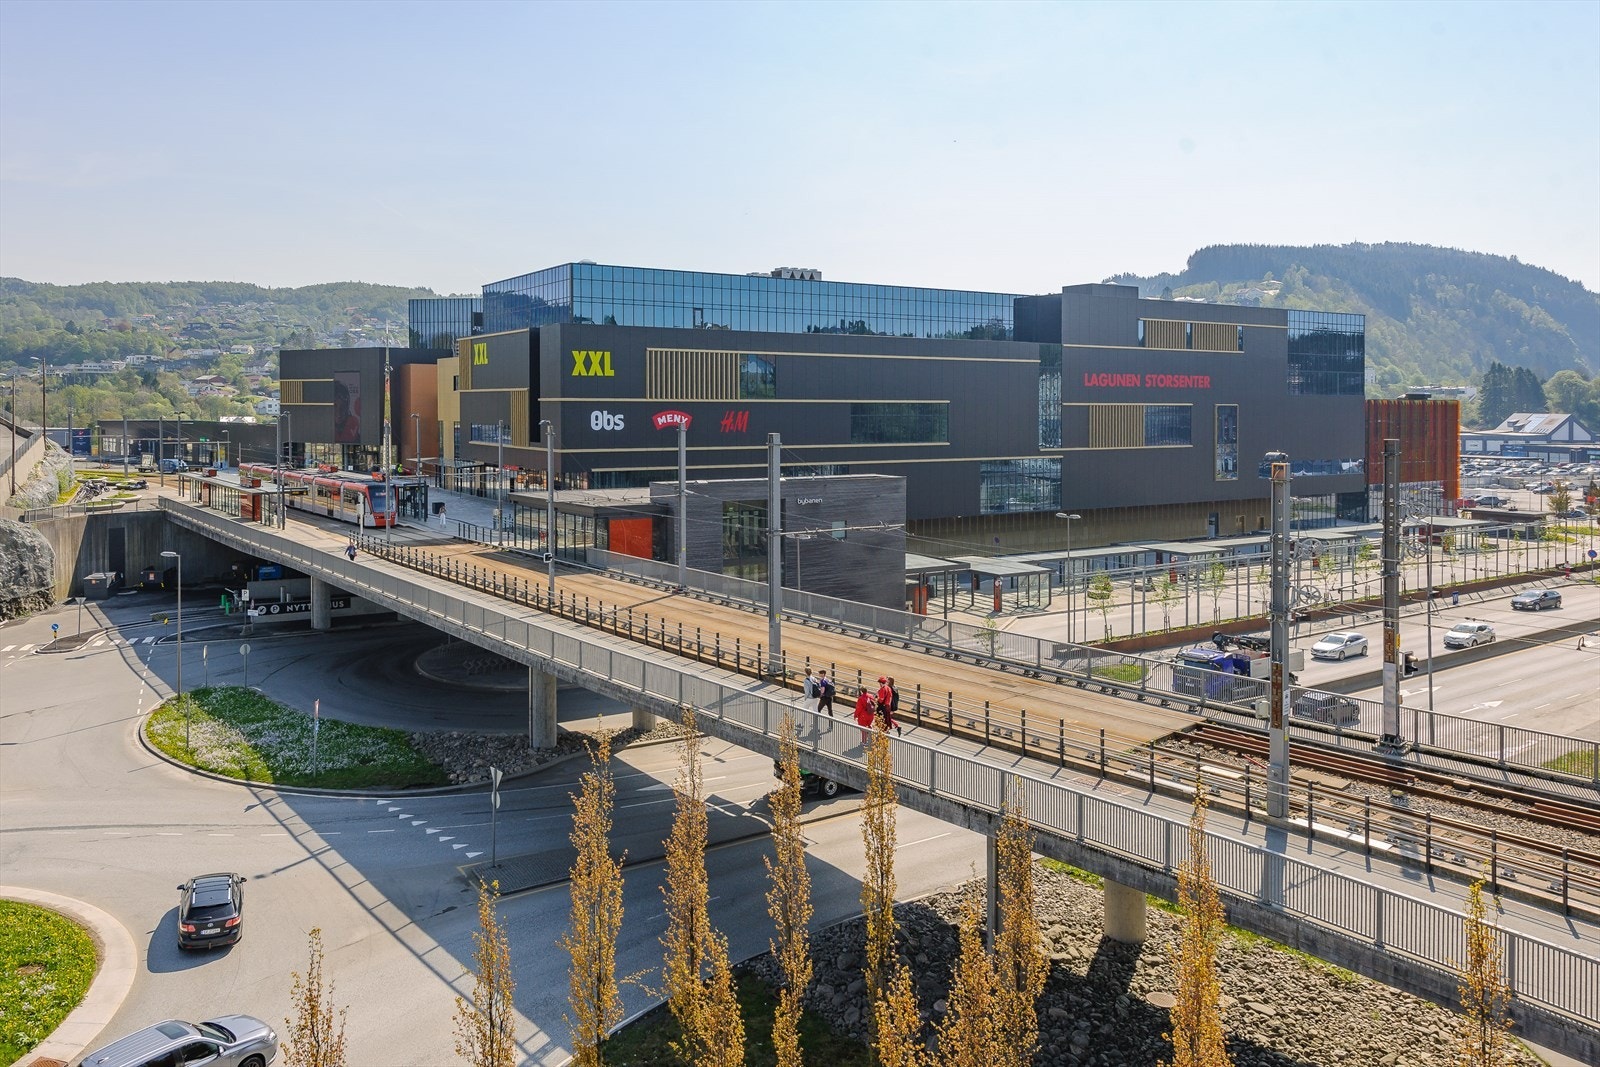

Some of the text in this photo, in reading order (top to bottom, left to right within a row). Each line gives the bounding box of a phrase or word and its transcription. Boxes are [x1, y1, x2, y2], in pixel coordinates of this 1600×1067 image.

[473, 343, 489, 366] XXL
[571, 350, 615, 377] XXL
[1084, 373, 1211, 389] LAGUNEN STORSENTER
[657, 414, 689, 425] MENY
[720, 410, 749, 432] H&M
[797, 497, 822, 505] bybanen
